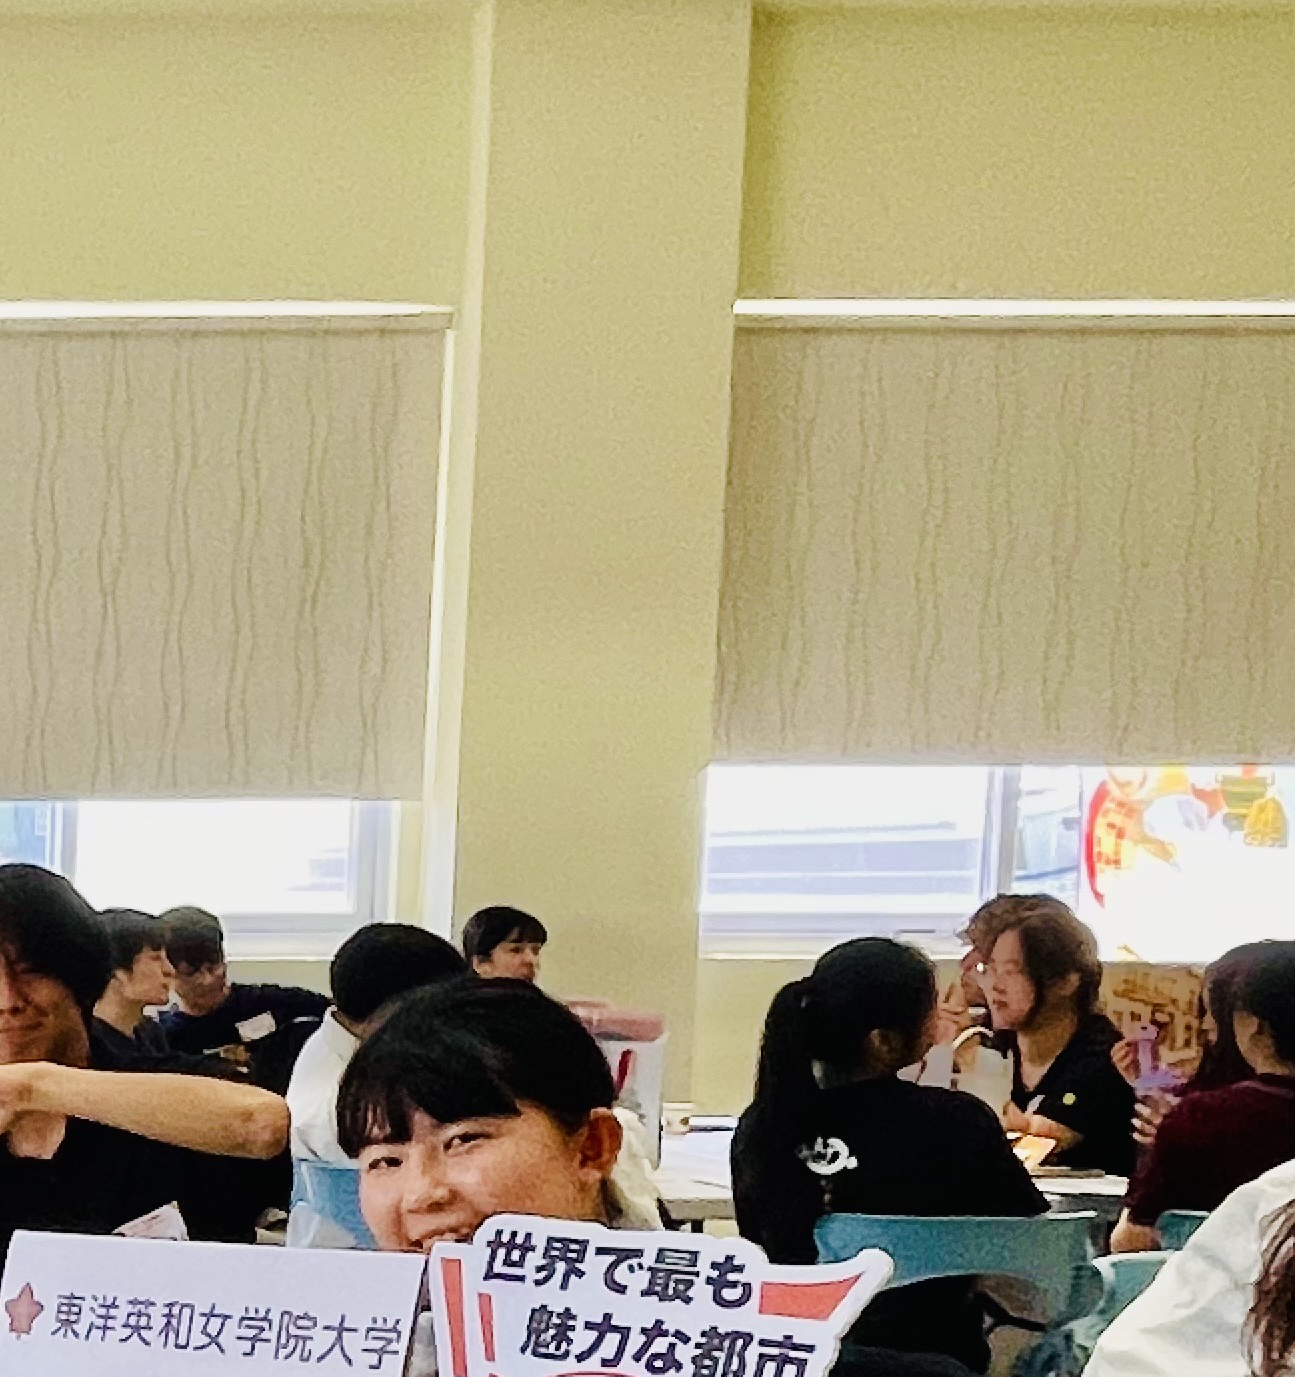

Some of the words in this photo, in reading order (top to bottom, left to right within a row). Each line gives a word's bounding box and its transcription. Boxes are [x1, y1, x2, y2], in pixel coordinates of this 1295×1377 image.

[482, 1228, 752, 1308] 世界で最も
[50, 1292, 402, 1370] 東洋英和女学院大学
